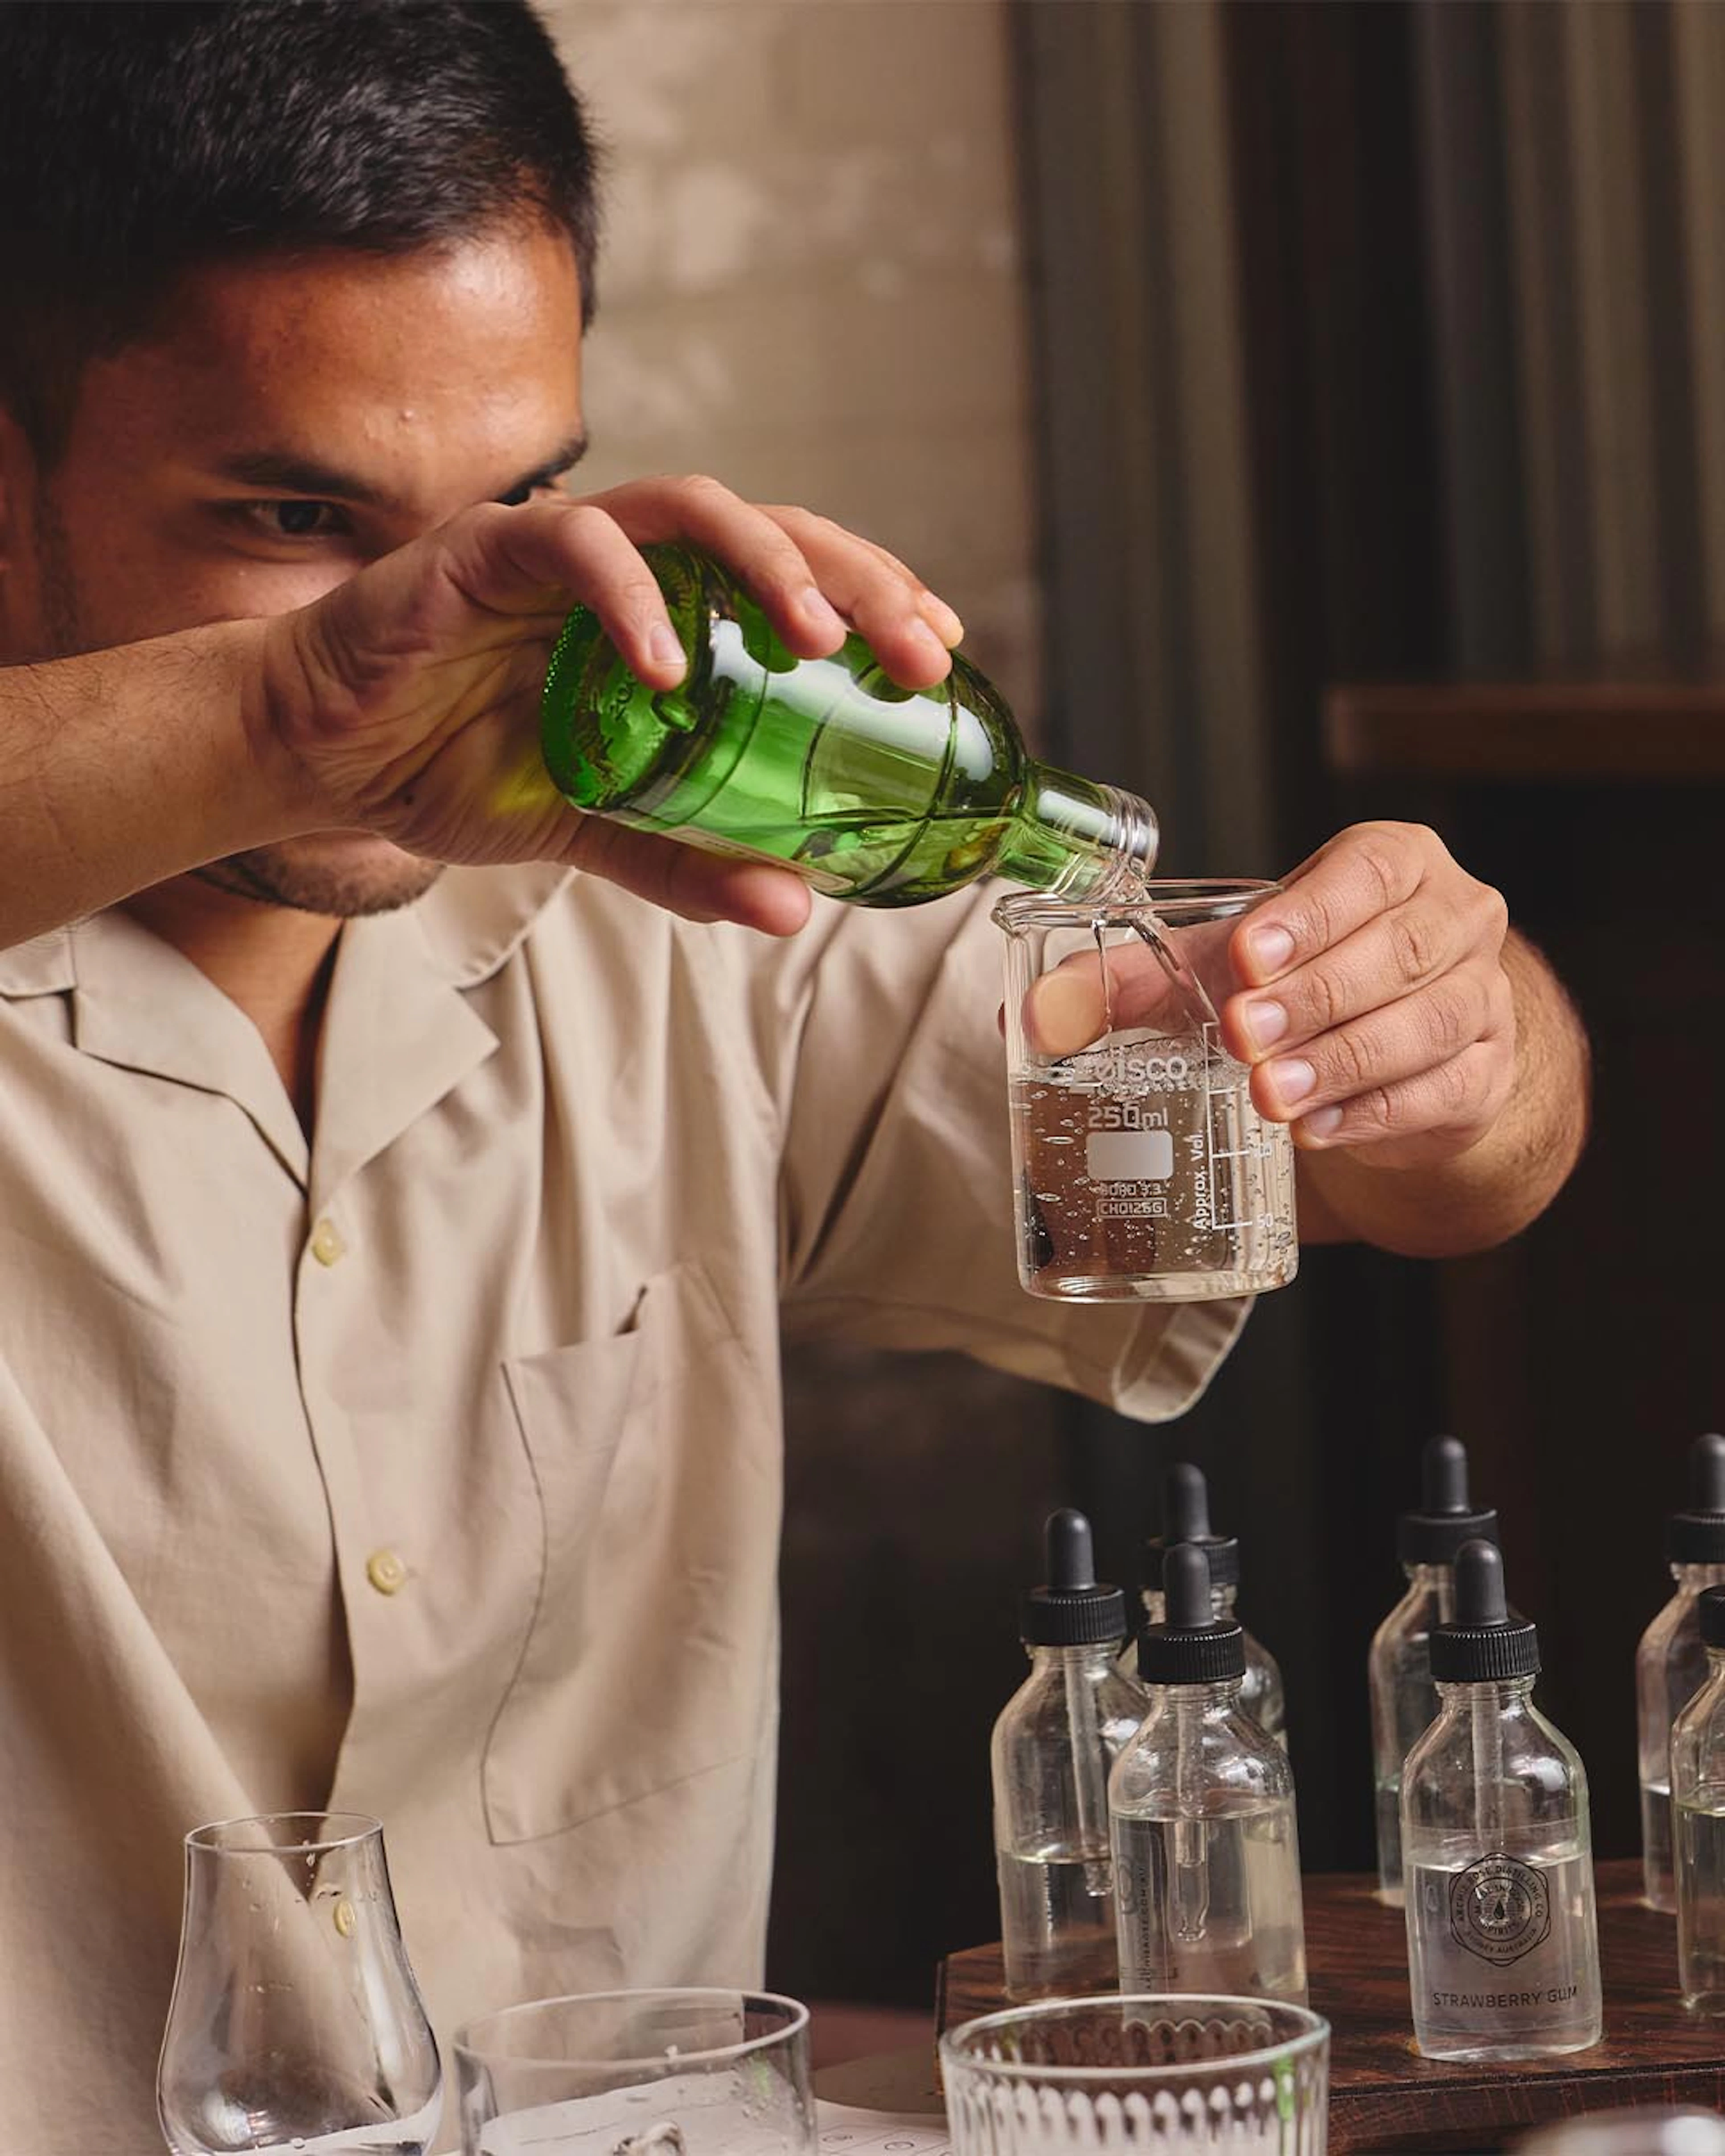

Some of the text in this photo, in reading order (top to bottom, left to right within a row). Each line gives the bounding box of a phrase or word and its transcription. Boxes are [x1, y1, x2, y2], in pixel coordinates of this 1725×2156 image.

[1088, 1105, 1169, 1129] 250ml
[1189, 1129, 1209, 1230] Approx. Vol.
[1433, 1985, 1577, 2008] STRAWBERRY GUM
